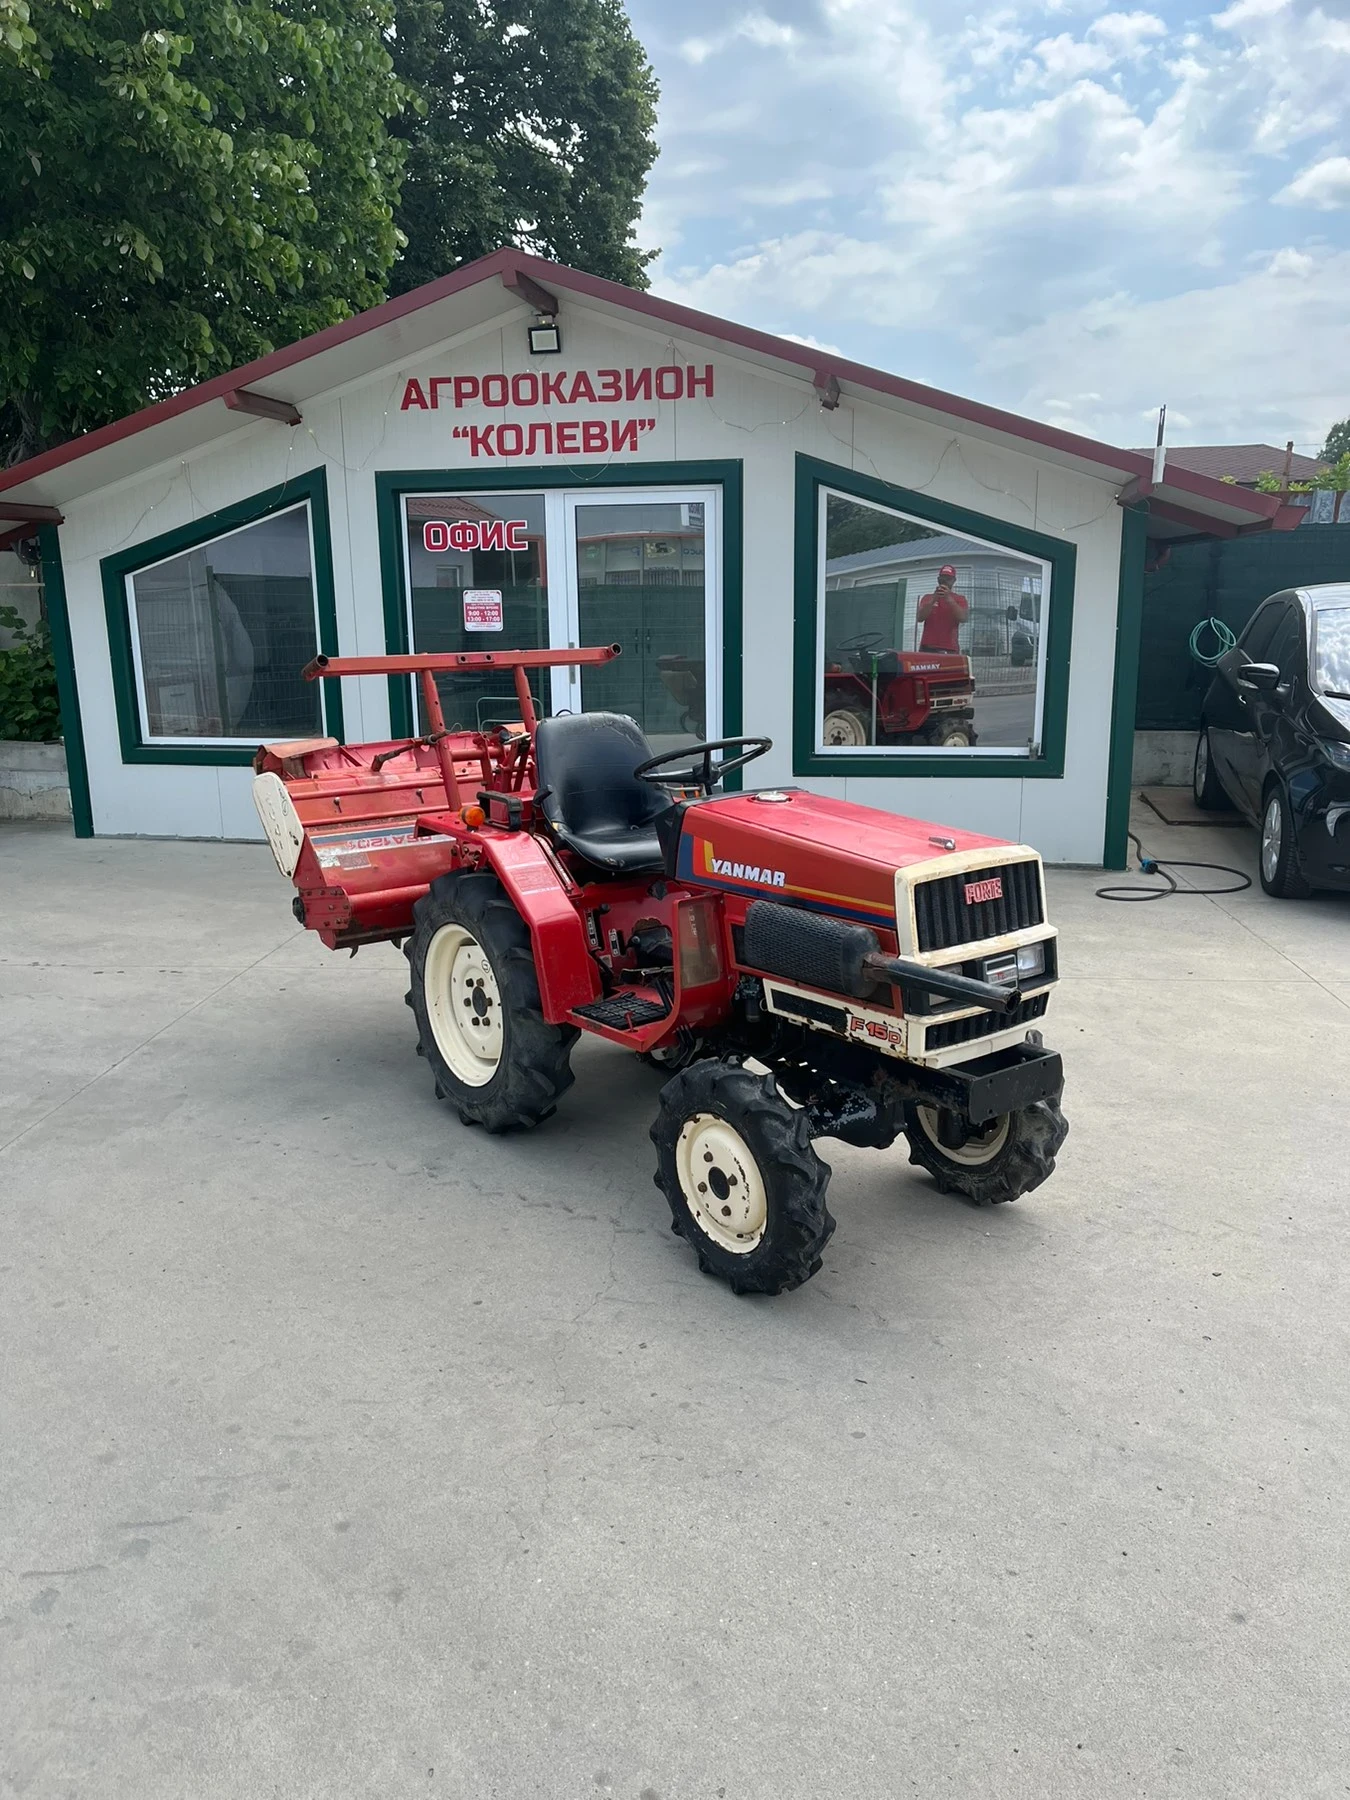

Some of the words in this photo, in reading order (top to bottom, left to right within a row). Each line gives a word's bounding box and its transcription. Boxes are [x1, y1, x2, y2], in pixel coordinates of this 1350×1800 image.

[400, 364, 714, 411] АГРООКАЗИОН
[423, 520, 528, 552] ОФИС
[711, 858, 786, 887] YANMAR
[964, 877, 1003, 905] FORTE
